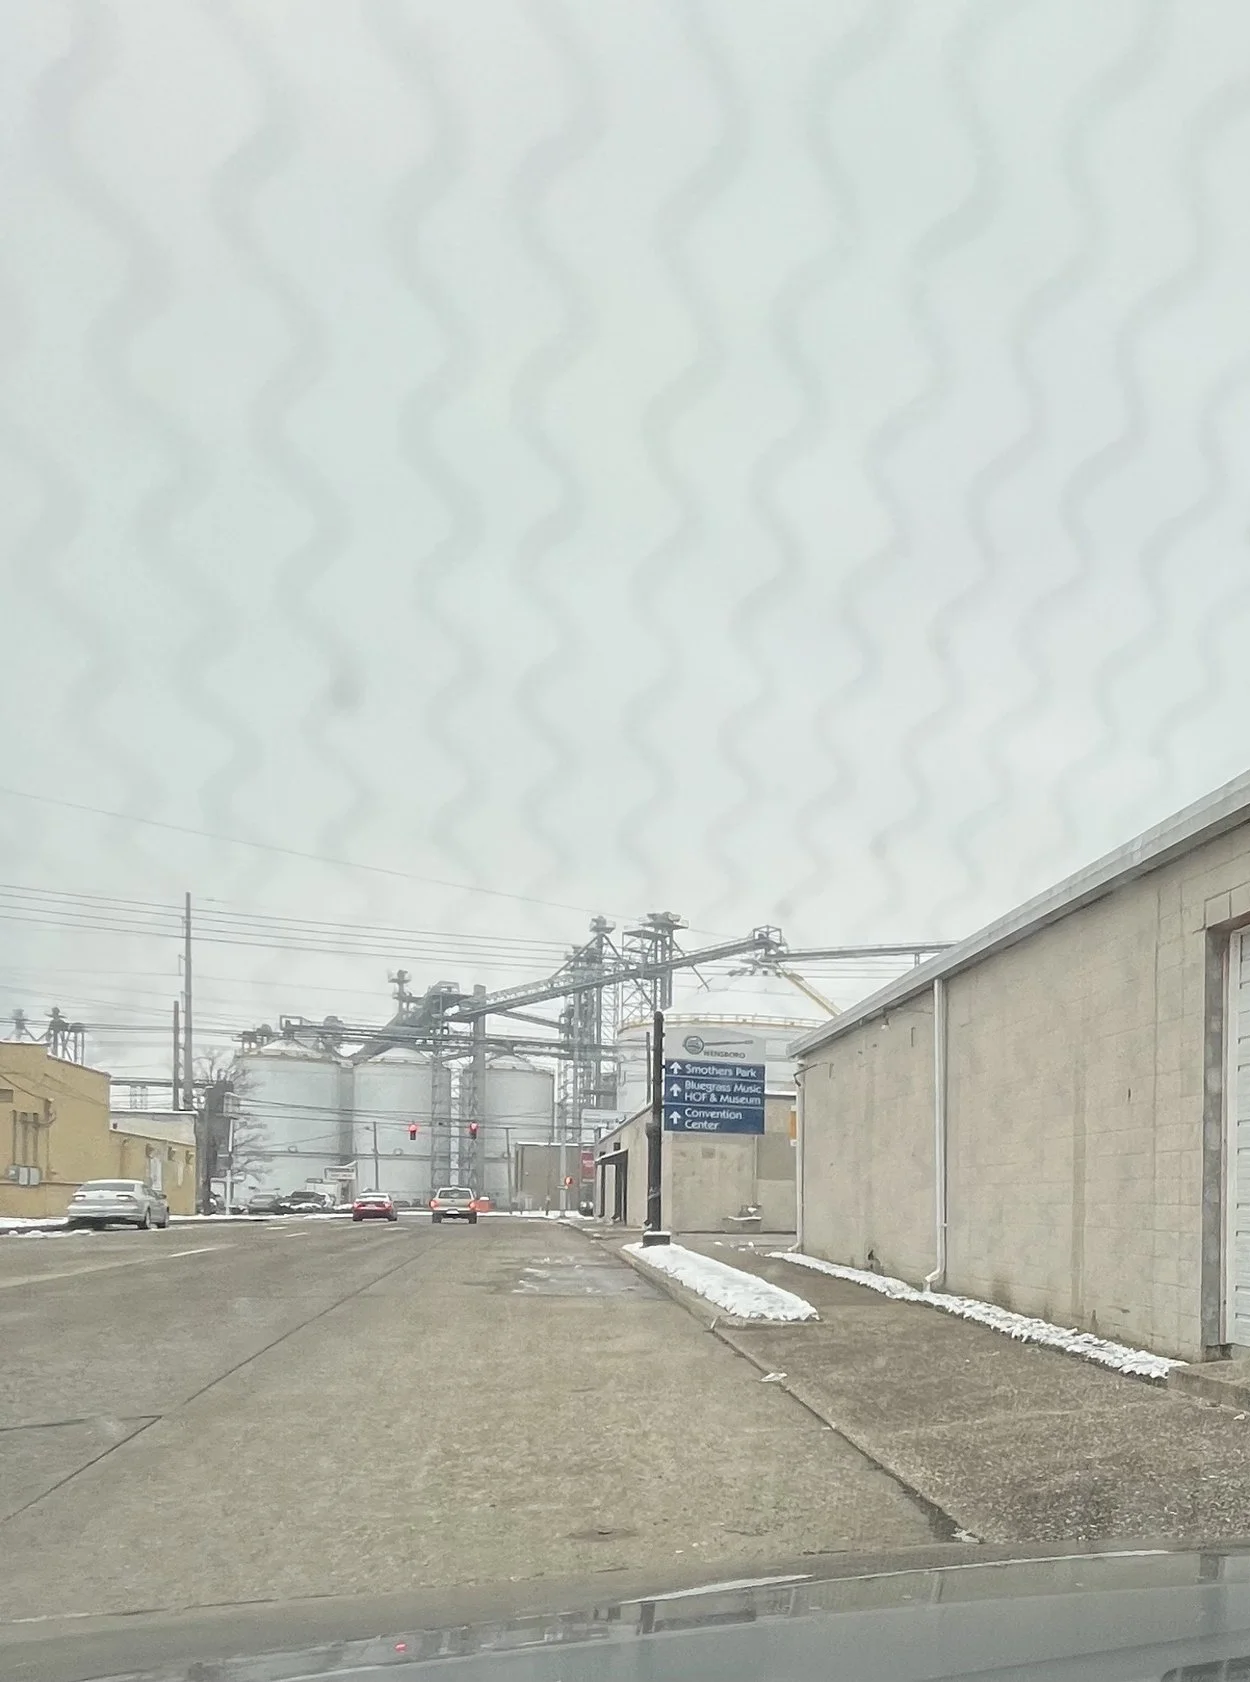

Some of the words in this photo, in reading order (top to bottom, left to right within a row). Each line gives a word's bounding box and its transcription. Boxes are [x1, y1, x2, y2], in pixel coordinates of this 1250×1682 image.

[684, 1063, 733, 1076] Smothers
[735, 1066, 757, 1078] Park
[684, 1080, 731, 1093] Bluegrass
[733, 1084, 762, 1094] Music
[684, 1092, 707, 1102] HOF
[709, 1094, 718, 1103] &
[719, 1095, 761, 1105] Museum
[684, 1107, 743, 1120] Convention
[684, 1119, 719, 1130] Center
